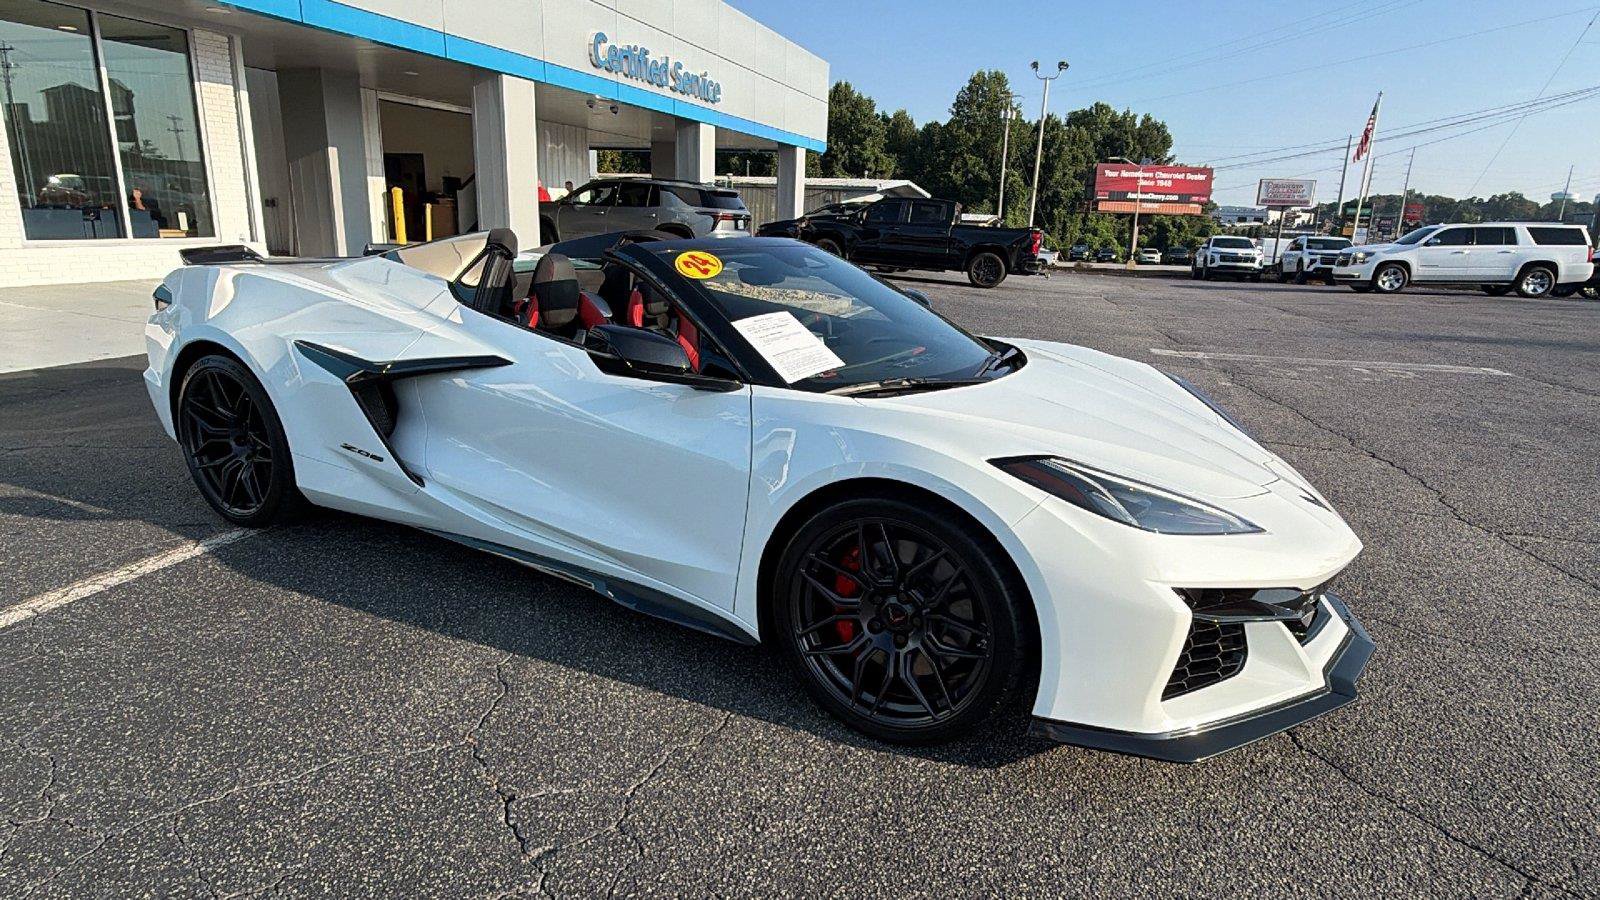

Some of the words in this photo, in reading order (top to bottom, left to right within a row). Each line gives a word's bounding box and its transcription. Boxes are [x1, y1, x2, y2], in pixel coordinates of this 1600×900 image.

[588, 31, 670, 88] Certified
[670, 61, 722, 104] Service
[1105, 169, 1119, 178] Your
[1120, 169, 1154, 179] Hometown
[1155, 171, 1186, 180] Chevrolet
[1186, 172, 1207, 181] Dealer
[682, 254, 718, 275] 24
